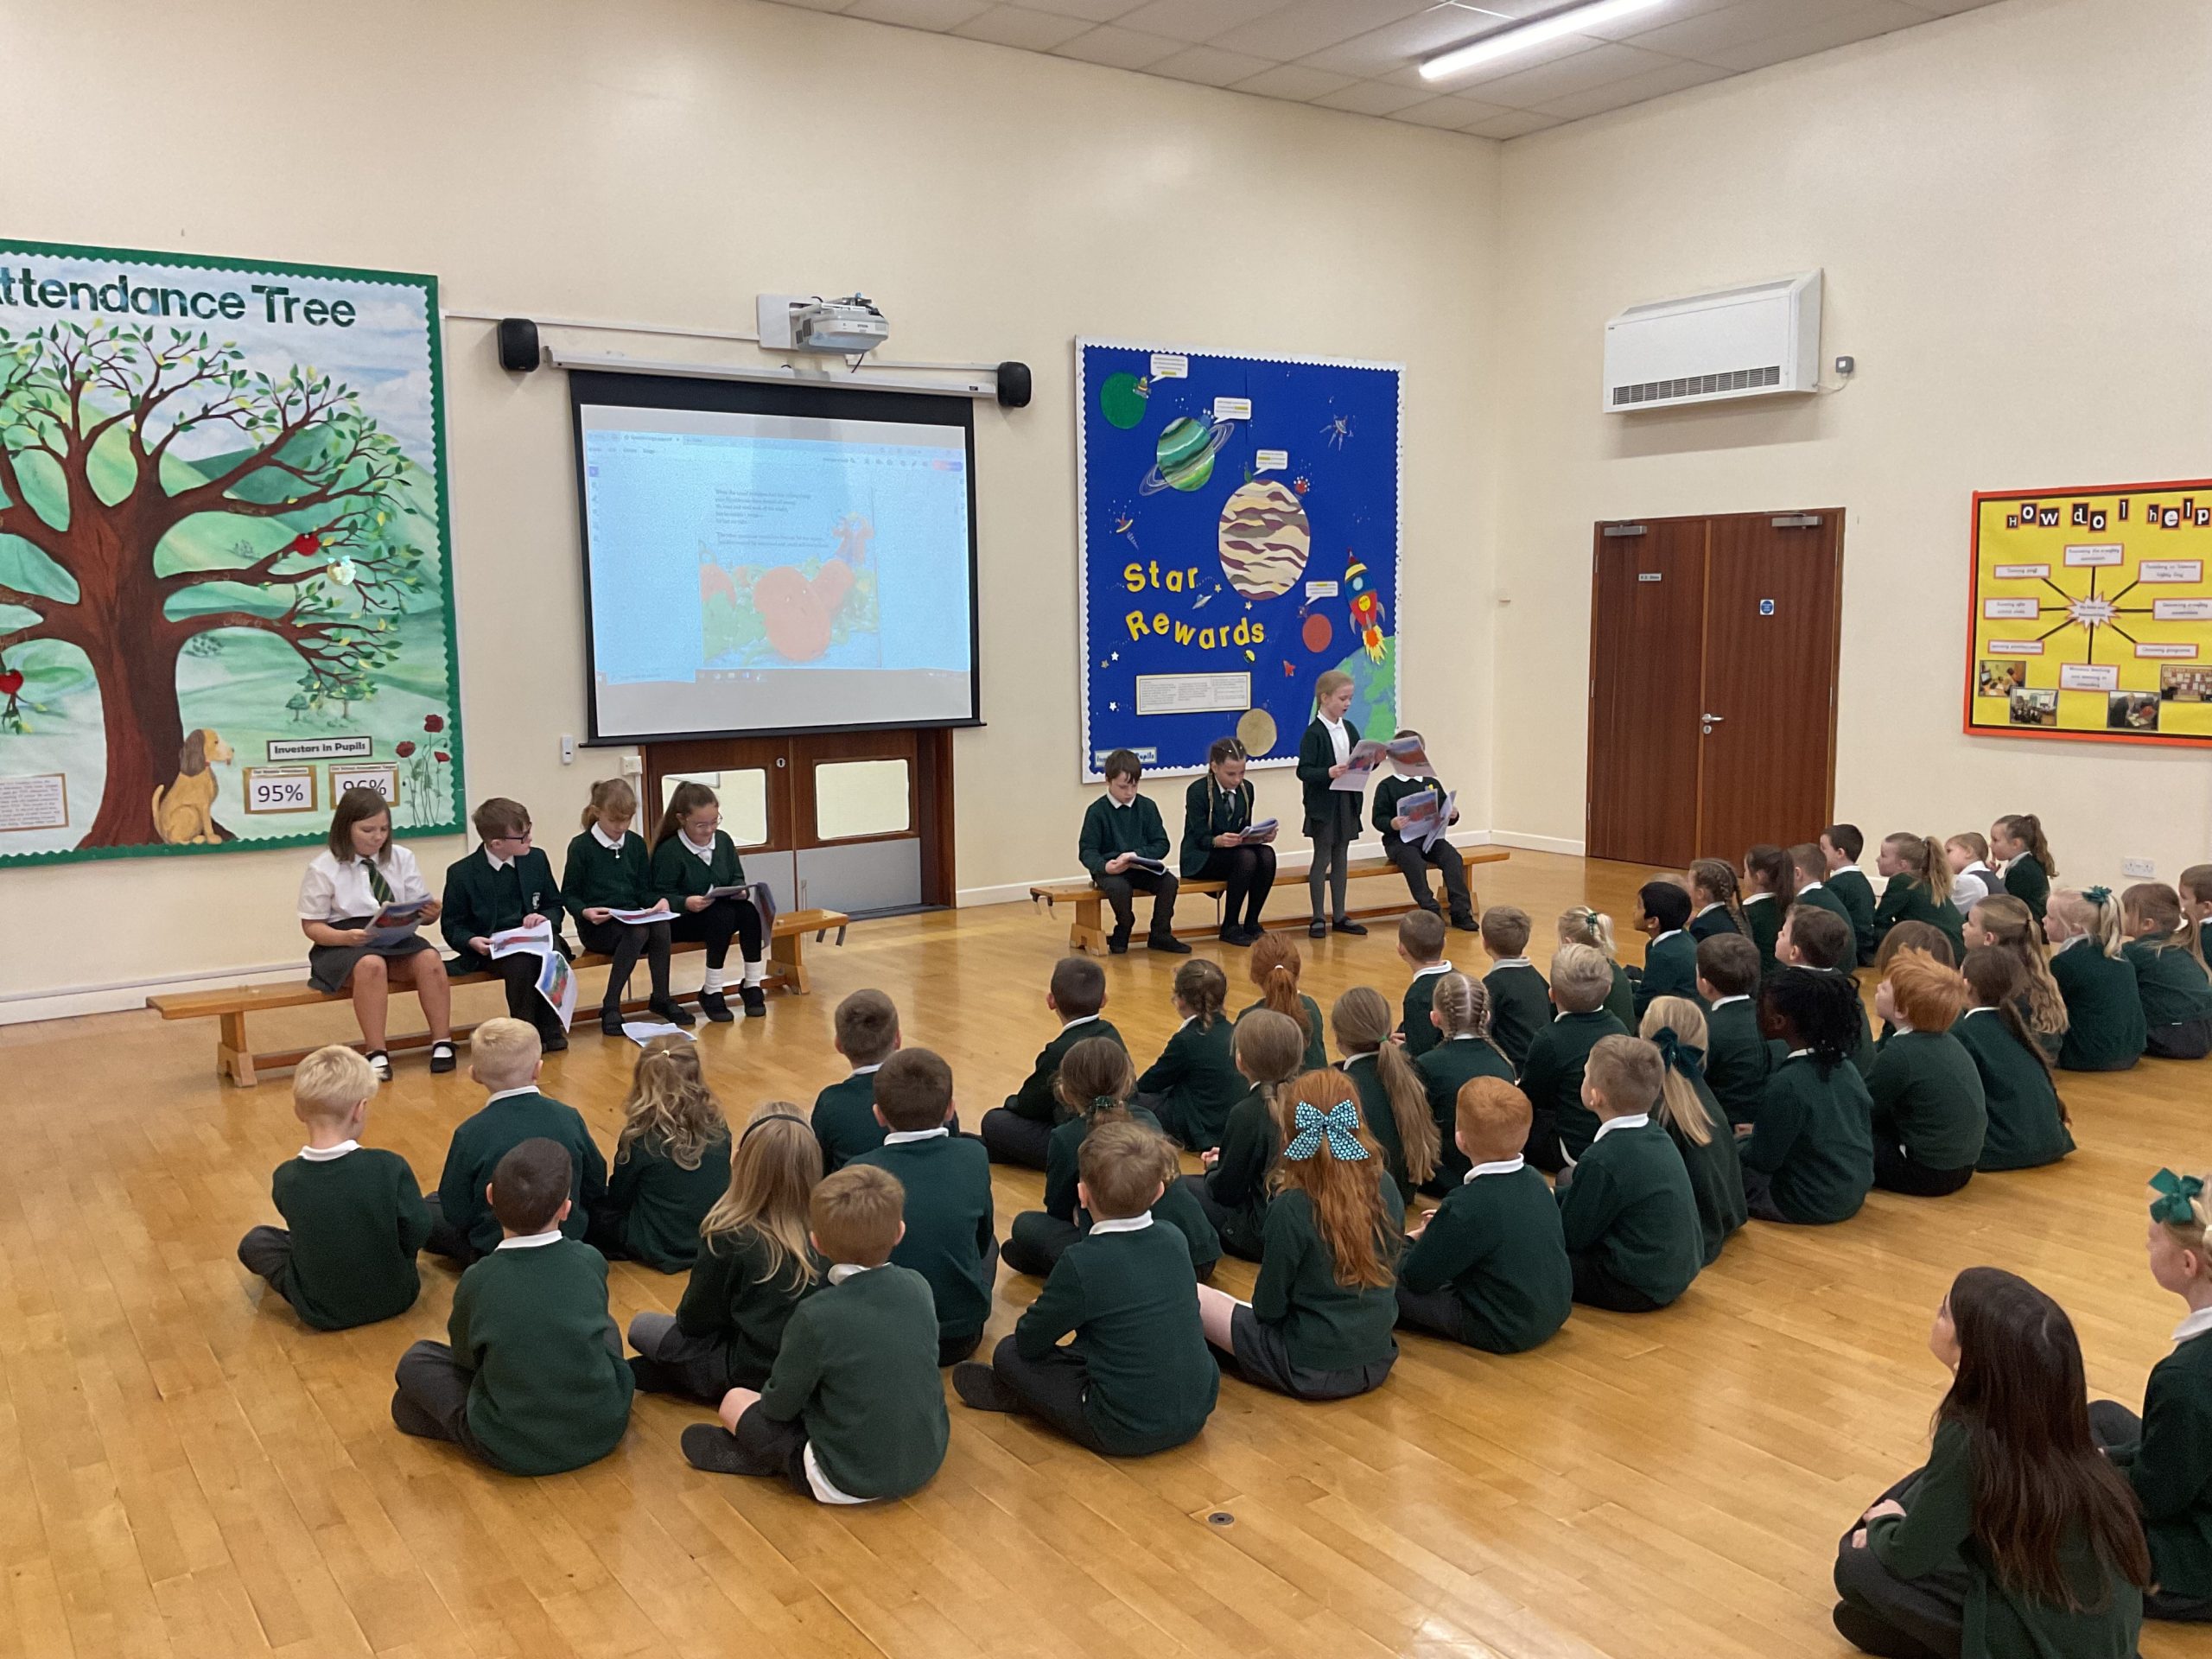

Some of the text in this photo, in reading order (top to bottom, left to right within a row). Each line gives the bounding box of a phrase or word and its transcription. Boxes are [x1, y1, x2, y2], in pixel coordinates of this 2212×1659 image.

[0, 267, 356, 327] ttendance Tree
[2074, 507, 2105, 529] do
[2149, 501, 2209, 526] help
[1123, 560, 1198, 593] Star
[1125, 609, 1265, 650] Rewards
[274, 741, 365, 754] Investors in Pupils
[257, 783, 304, 803] 95%
